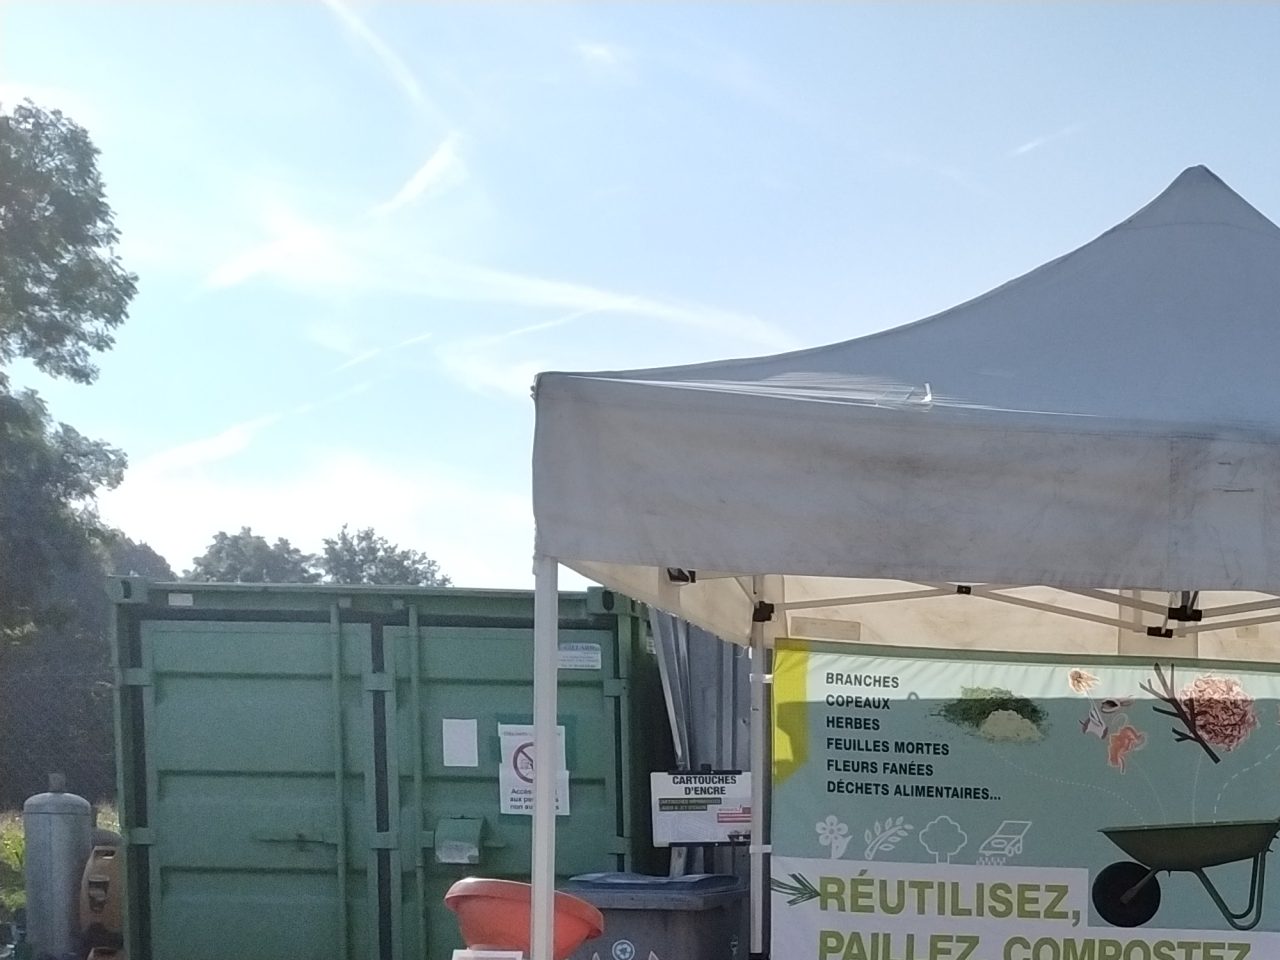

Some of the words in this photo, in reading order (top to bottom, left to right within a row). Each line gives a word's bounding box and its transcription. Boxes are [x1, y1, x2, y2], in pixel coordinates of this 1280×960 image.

[826, 672, 900, 689] BRANCHES
[826, 694, 890, 710] COPEAUX
[826, 715, 880, 731] HERBES
[827, 737, 890, 753] FEUILLES
[894, 740, 950, 756] MORTES
[827, 759, 878, 774] FLEURS
[883, 760, 934, 777] FANÉES
[672, 776, 737, 785] CARTOUCHES
[684, 786, 726, 795] D'ENCRE
[827, 778, 890, 796] DÉCHETS
[894, 784, 1001, 801] ALIMENTAIRES...
[819, 869, 1080, 927] RÉUTILISEZ,
